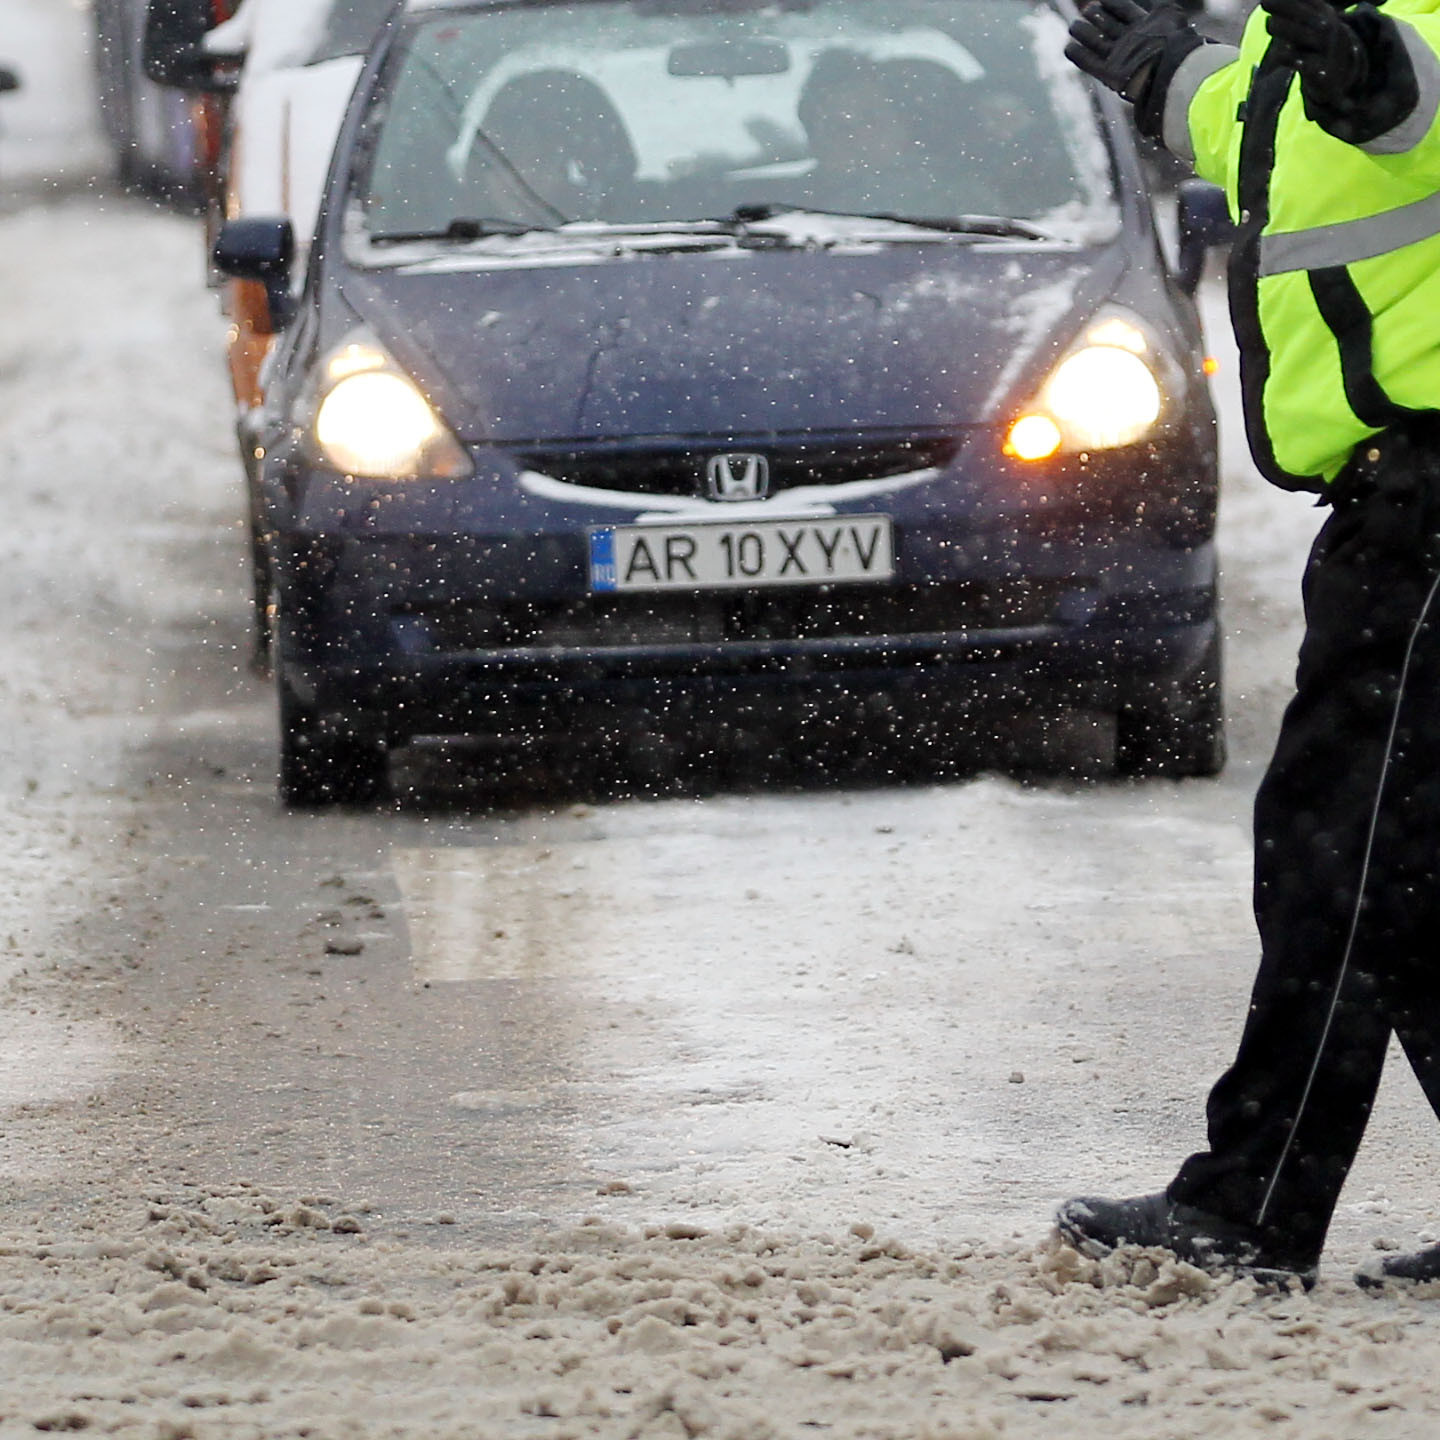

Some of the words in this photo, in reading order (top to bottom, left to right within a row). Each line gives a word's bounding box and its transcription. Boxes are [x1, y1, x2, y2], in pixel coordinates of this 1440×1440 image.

[625, 535, 697, 583] AR
[719, 532, 764, 578] 10
[777, 526, 881, 576] XYV
